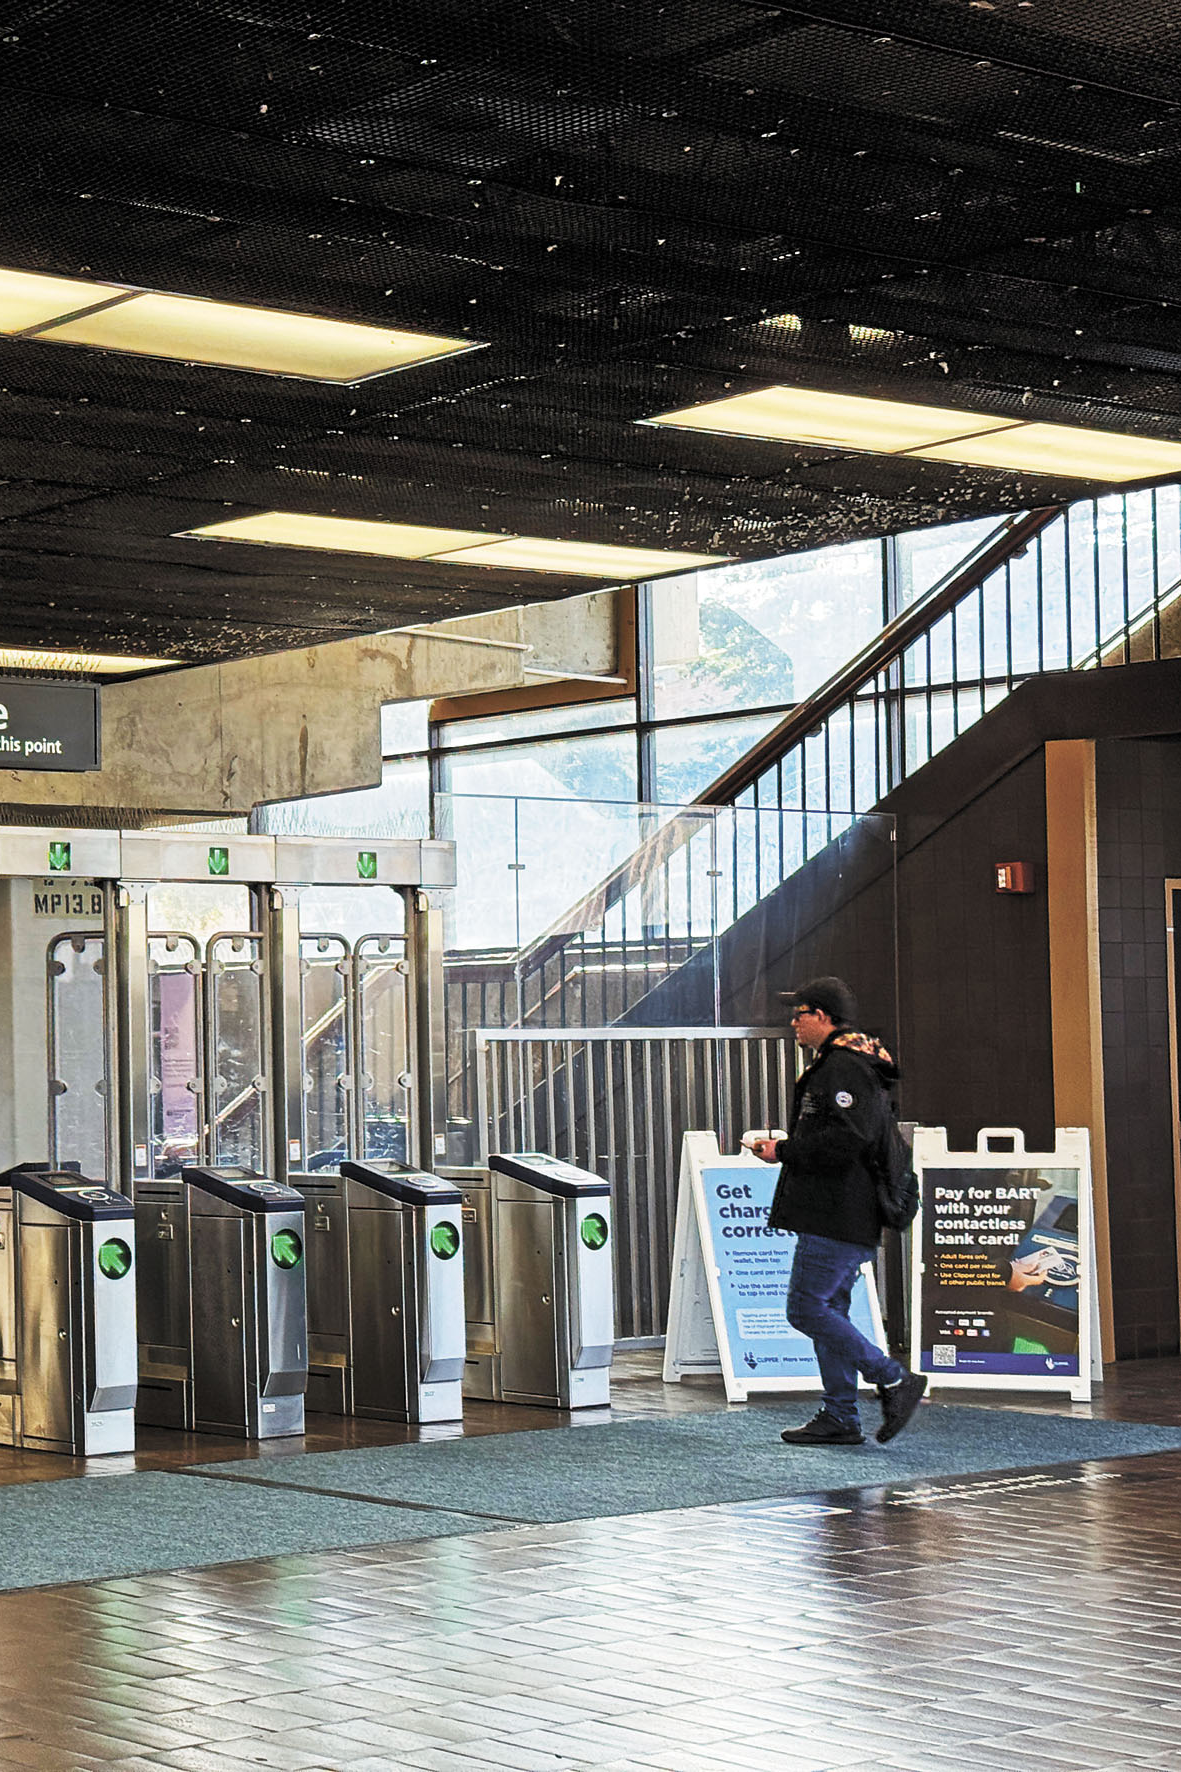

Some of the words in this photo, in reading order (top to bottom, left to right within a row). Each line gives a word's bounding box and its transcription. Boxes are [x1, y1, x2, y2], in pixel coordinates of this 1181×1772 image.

[25, 737, 63, 756] point
[716, 1184, 753, 1199] Get
[934, 1187, 964, 1201] Pay
[968, 1186, 993, 1199] for
[995, 1187, 1041, 1199] BART
[719, 1202, 772, 1220] charg
[934, 1202, 969, 1214] with
[973, 1205, 1011, 1217] your
[721, 1225, 795, 1238] correc
[934, 1218, 1026, 1230] contactless
[934, 1232, 975, 1245] bank
[977, 1233, 1019, 1245] card!
